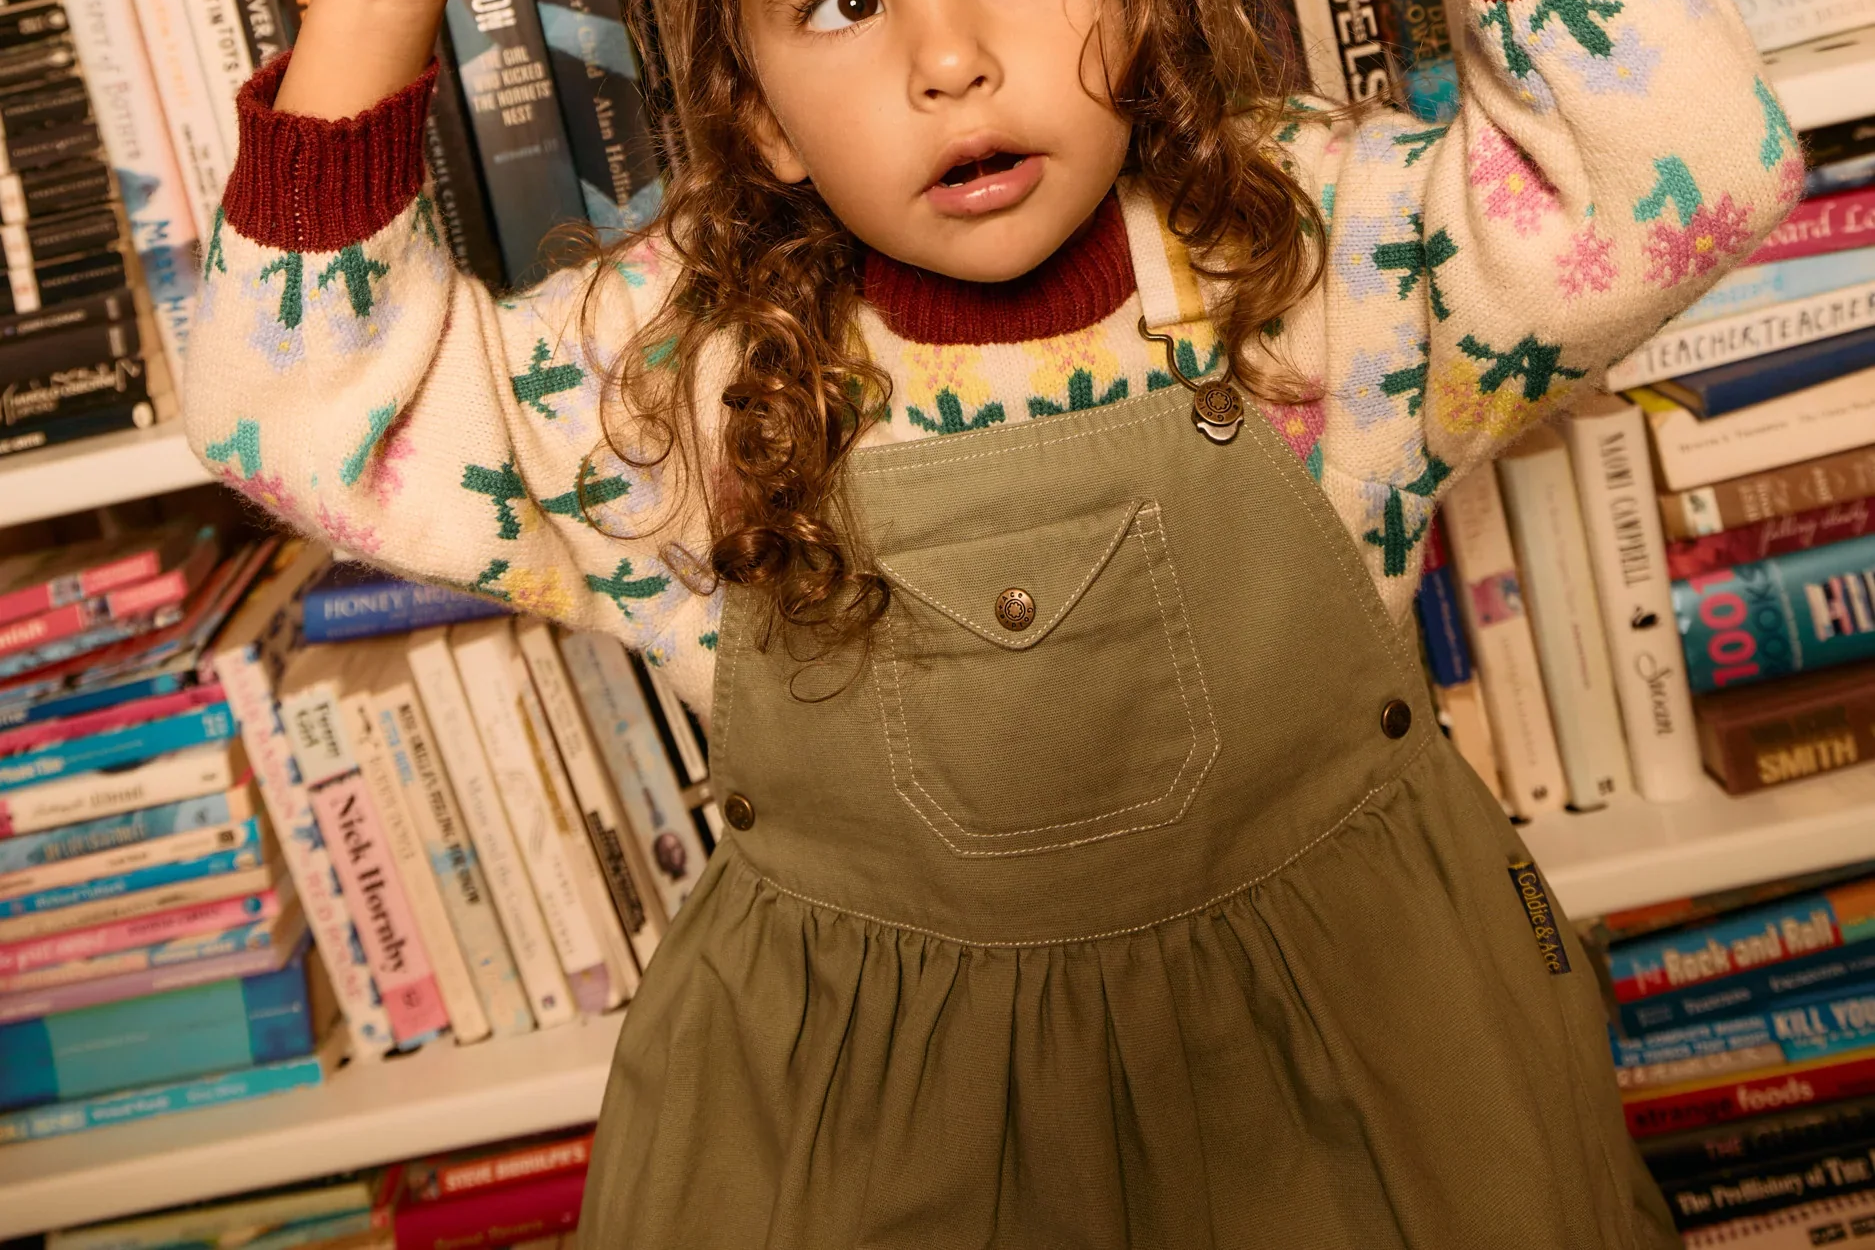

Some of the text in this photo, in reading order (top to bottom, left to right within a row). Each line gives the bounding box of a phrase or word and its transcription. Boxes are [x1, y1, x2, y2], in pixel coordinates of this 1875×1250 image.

[500, 62, 545, 88] KICKED
[502, 45, 532, 68] GIRL
[574, 23, 604, 80] Child
[590, 94, 620, 141] Alan
[102, 79, 149, 163] BOTHER
[471, 92, 498, 114] THE
[501, 104, 535, 128] NEST
[141, 219, 176, 297] MARK
[321, 587, 405, 621] HONEY
[1594, 430, 1686, 742] NAOMI CAMPBELL Swan
[1697, 565, 1762, 688] 1001
[291, 707, 320, 750] Girl
[310, 700, 344, 761] Funny
[1756, 734, 1859, 786] SMITH
[326, 791, 417, 981] Nick Hornby
[1516, 869, 1566, 972] Goldie & Ace
[1661, 906, 1835, 988] Rock and Roll
[1771, 1003, 1828, 1042] KILL
[1633, 1073, 1816, 1131] strange foods
[1675, 1187, 1712, 1215] The
[1803, 1162, 1826, 1189] of
